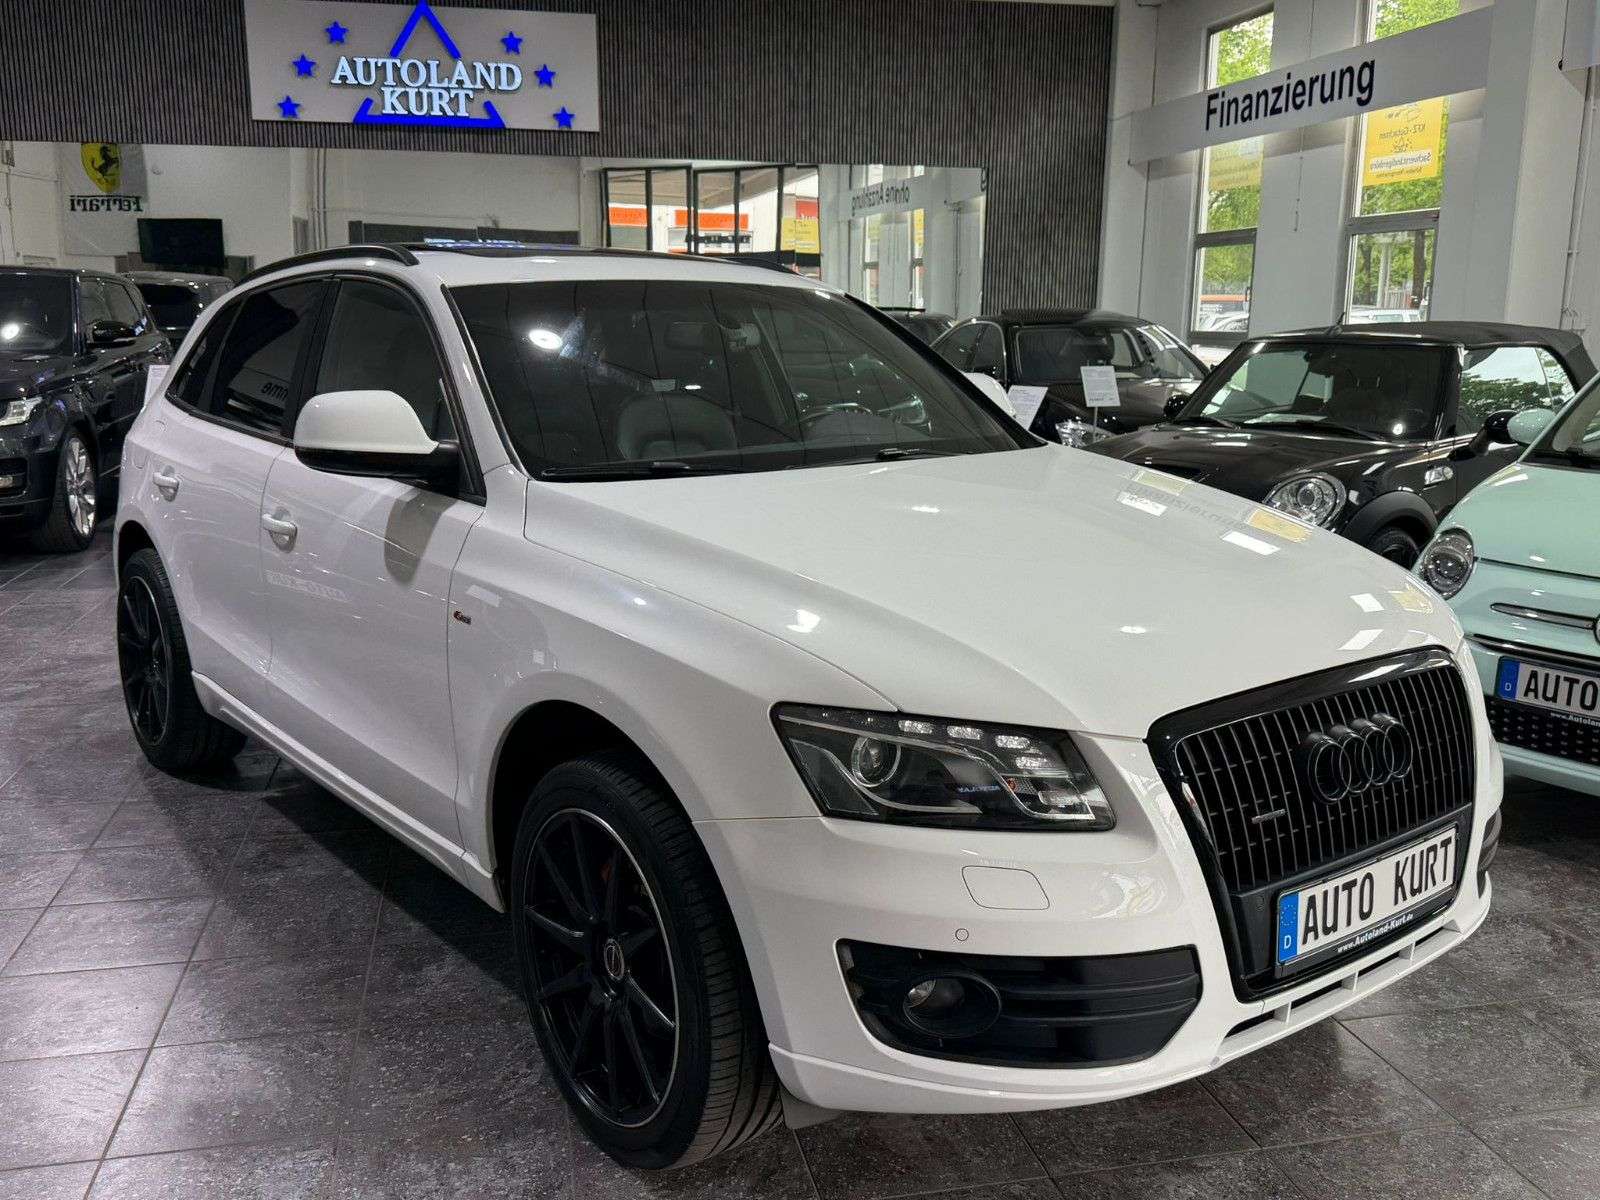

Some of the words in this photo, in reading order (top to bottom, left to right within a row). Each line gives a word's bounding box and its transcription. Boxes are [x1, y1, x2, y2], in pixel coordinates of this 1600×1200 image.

[331, 56, 522, 91] AUTOLAND
[381, 87, 474, 117] KURT
[1205, 59, 1376, 131] Finanzierung
[1523, 669, 1599, 711] AUTO
[1283, 935, 1292, 949] D
[1302, 872, 1374, 945] AUTO
[1394, 836, 1452, 906] KURT
